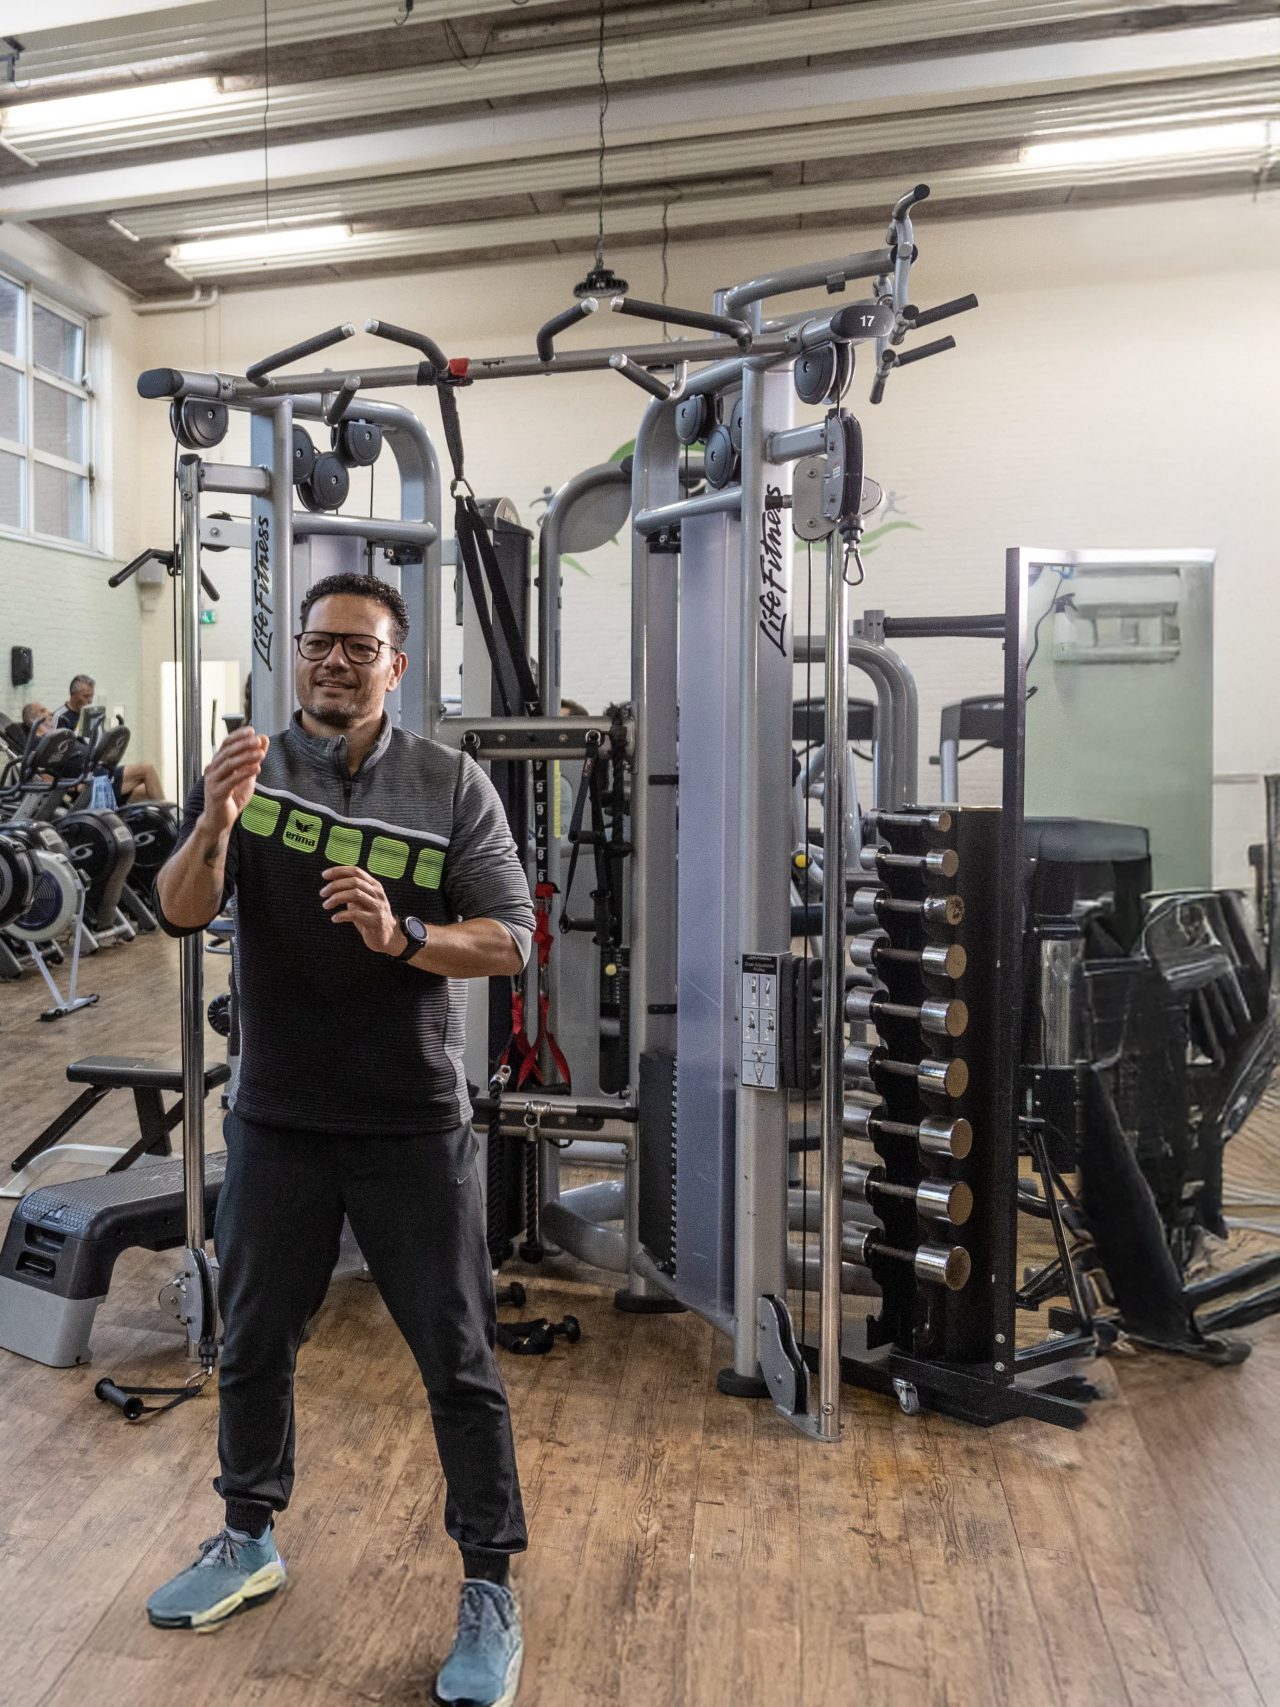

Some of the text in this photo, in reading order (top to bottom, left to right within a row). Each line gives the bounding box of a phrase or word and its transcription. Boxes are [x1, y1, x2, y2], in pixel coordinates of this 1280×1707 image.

[860, 315, 875, 327] 17
[759, 484, 788, 657] Life Fitnes
[253, 515, 274, 672] Life Fitness
[285, 831, 316, 847] erima
[537, 849, 544, 860] 8
